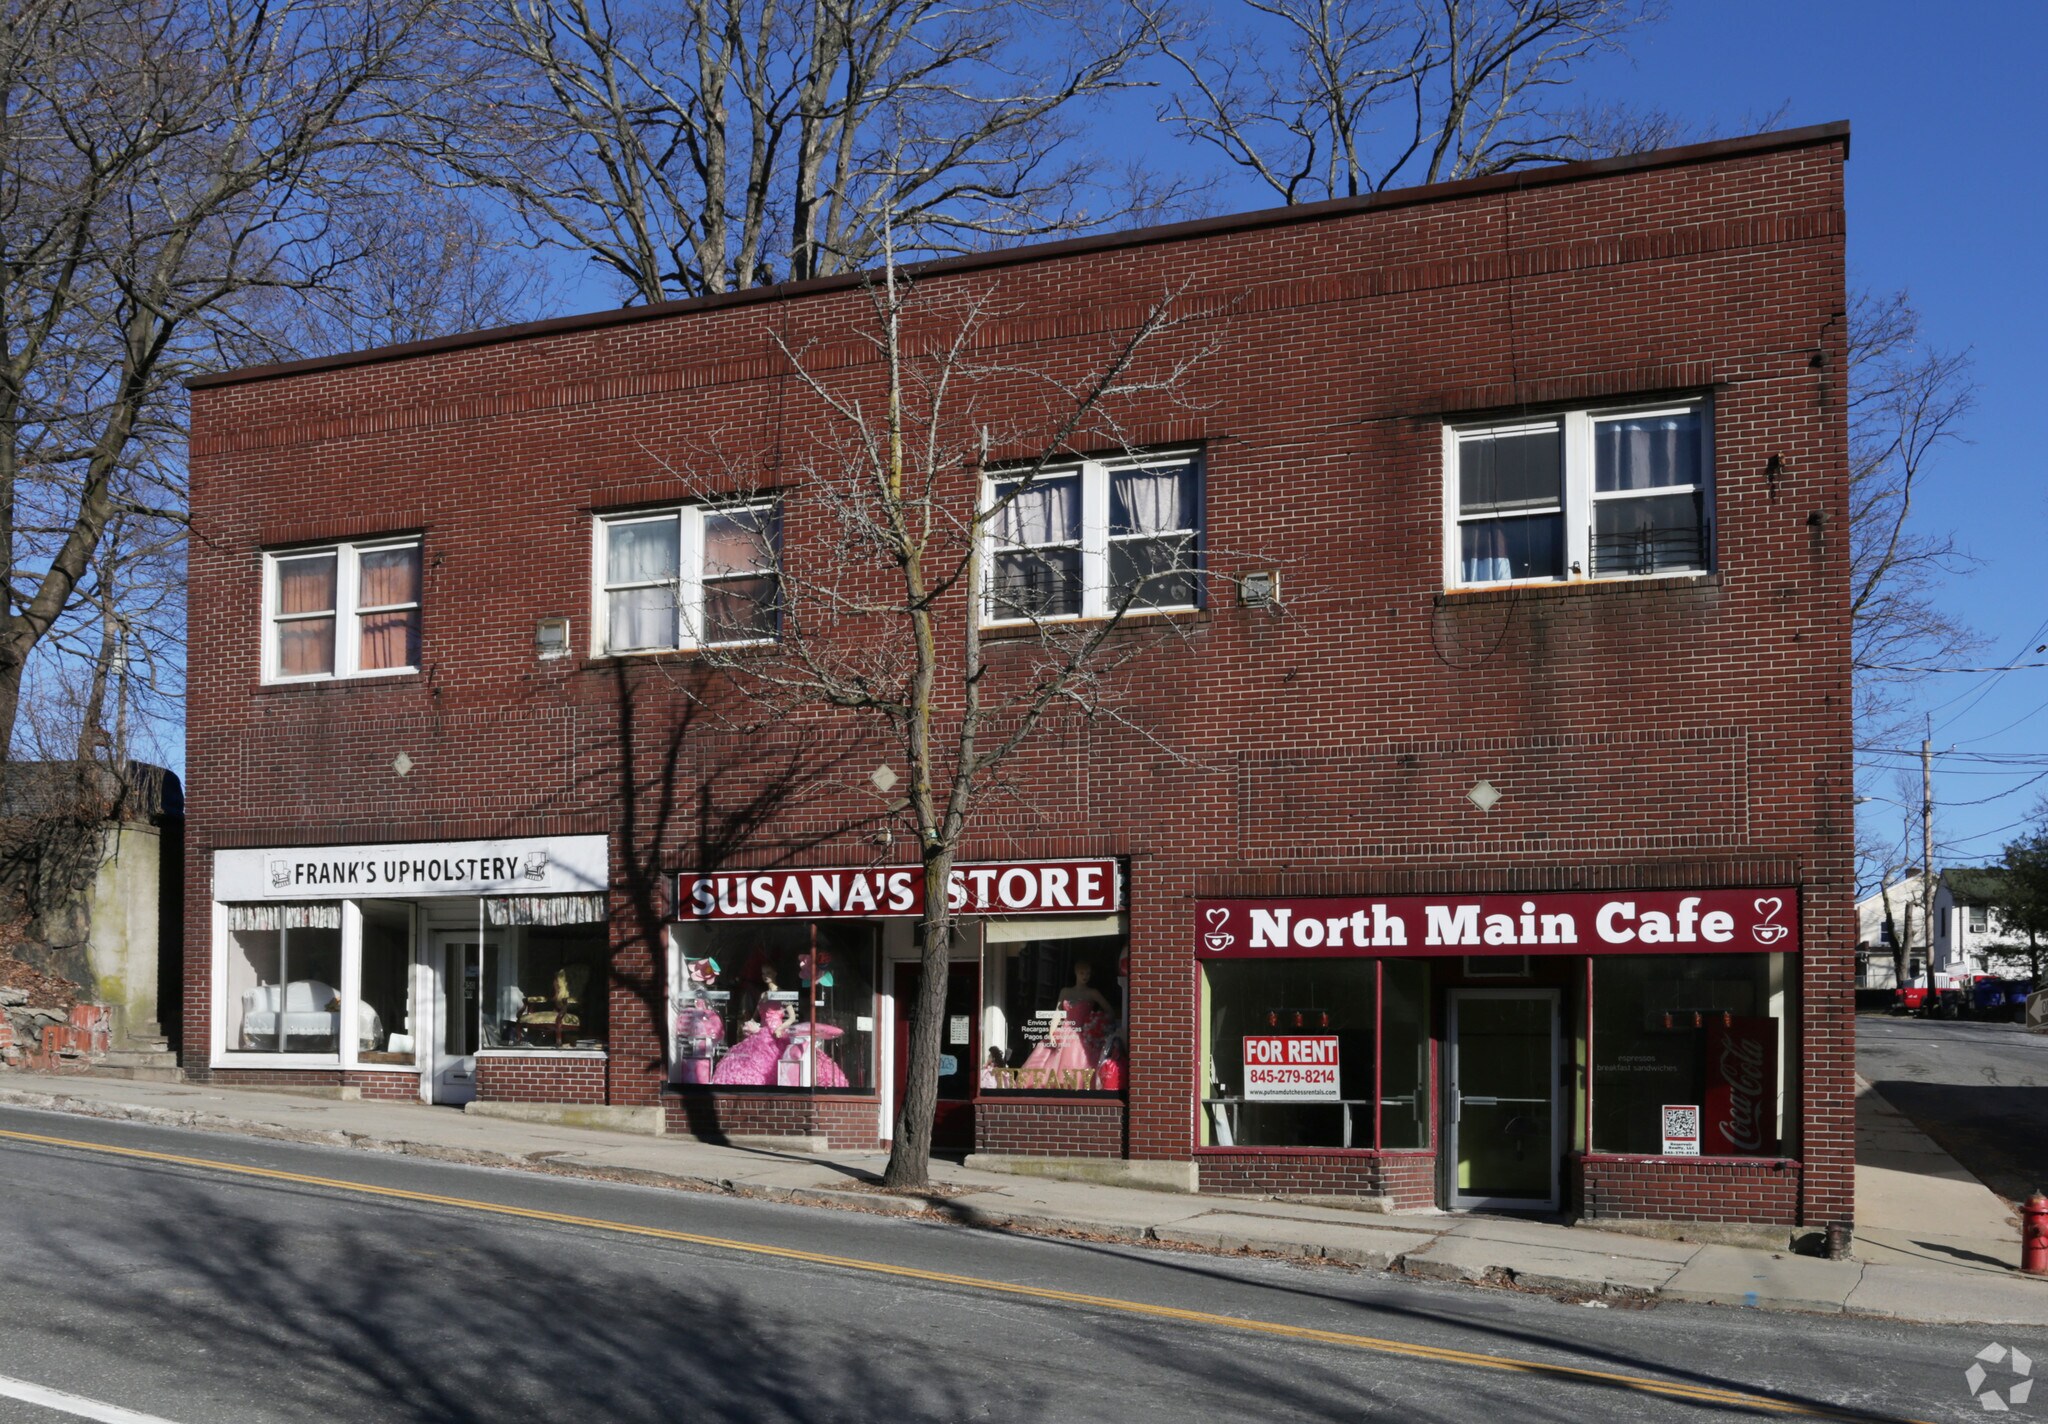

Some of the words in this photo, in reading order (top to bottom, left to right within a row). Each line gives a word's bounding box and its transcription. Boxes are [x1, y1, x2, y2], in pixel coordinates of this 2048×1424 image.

[295, 861, 377, 885] FRANK'S
[384, 857, 519, 883] UPHOLSTERY
[691, 872, 915, 917] SUSANA'S
[946, 867, 1106, 910] STORE
[1249, 903, 1408, 949] North
[1424, 901, 1578, 946] Main
[1595, 896, 1735, 944] Cafe
[1246, 1040, 1284, 1063] FOR
[1288, 1040, 1337, 1063] RENT
[1250, 1069, 1335, 1084] 845-279-8214
[1249, 1088, 1337, 1097] www.putnamdutchessrentals.com
